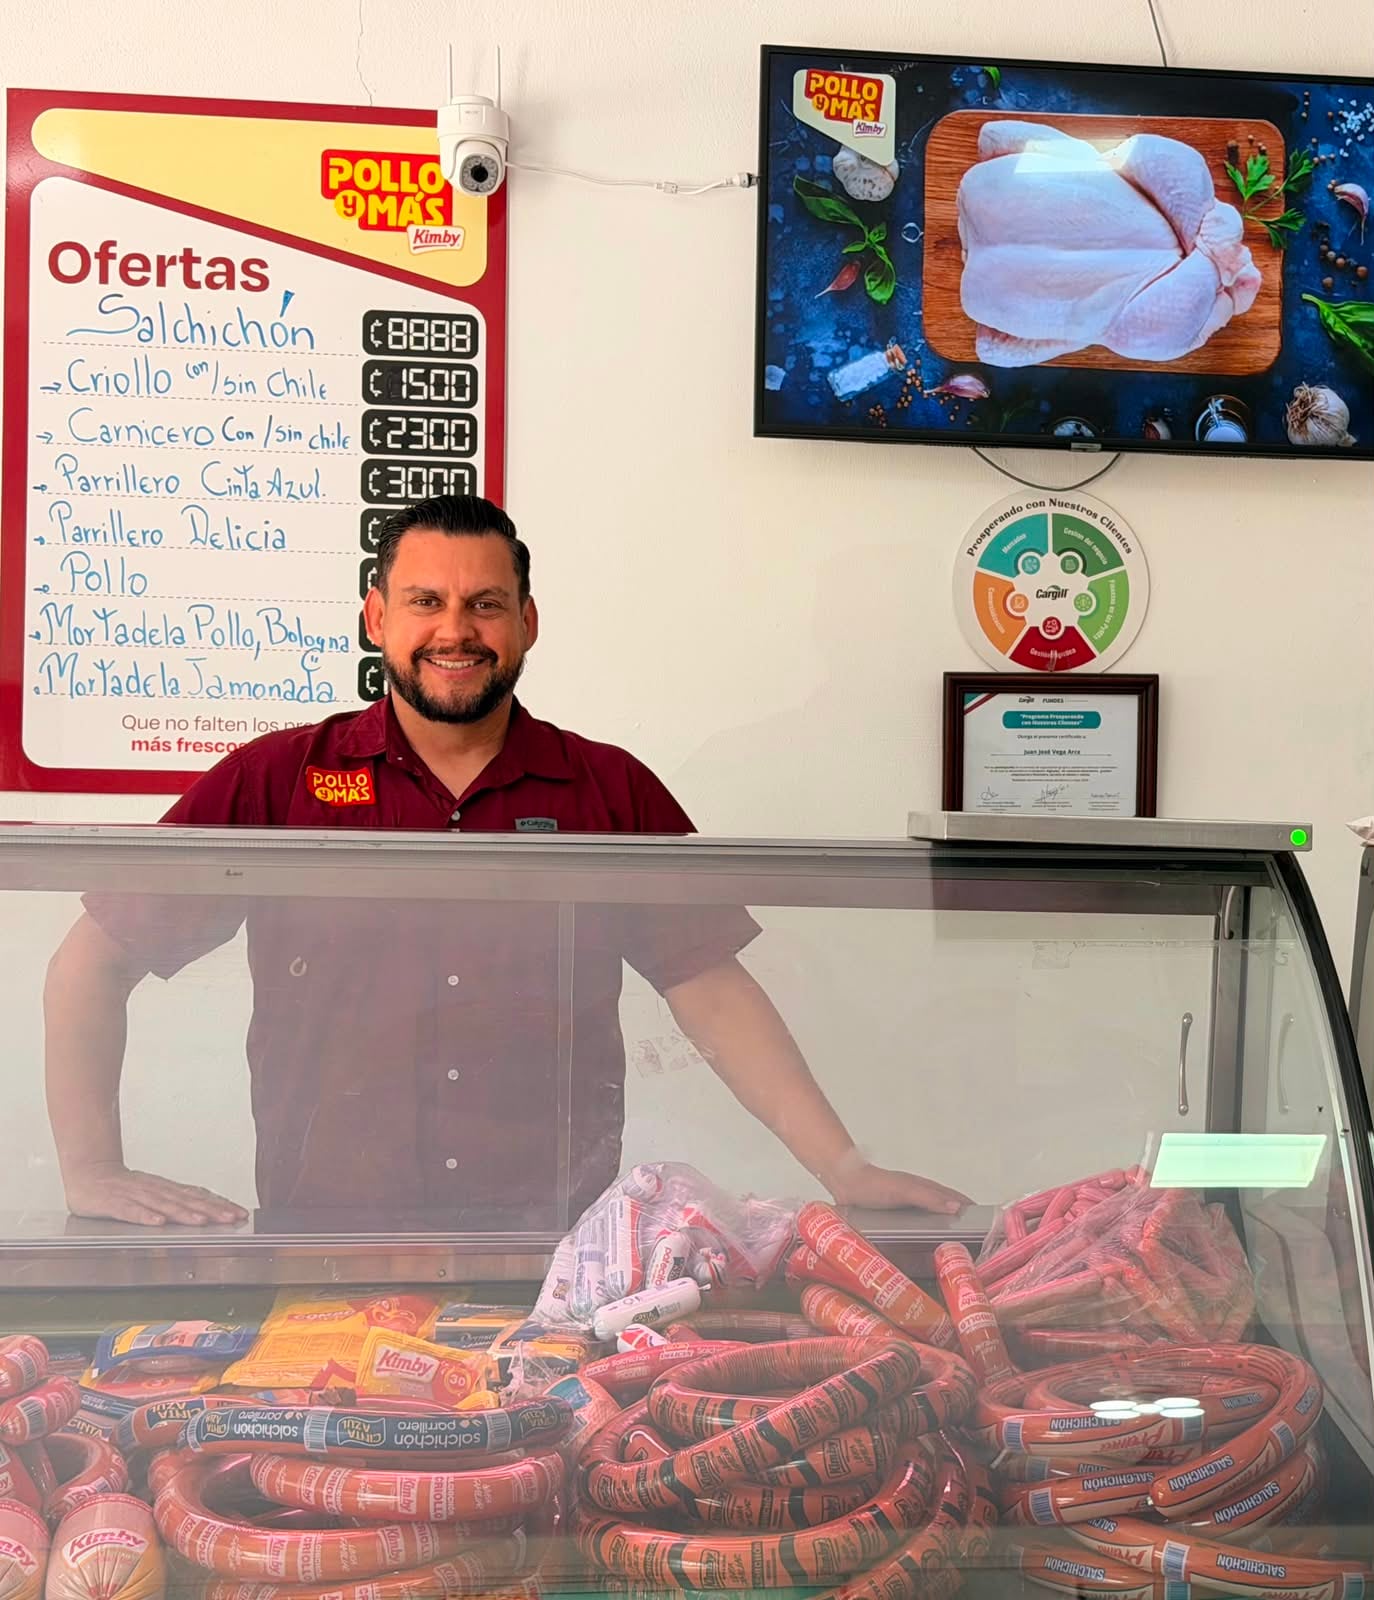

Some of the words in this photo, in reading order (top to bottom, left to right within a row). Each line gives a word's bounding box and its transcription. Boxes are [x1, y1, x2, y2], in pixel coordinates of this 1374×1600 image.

[809, 73, 879, 101] POLLO
[829, 98, 876, 122] MÁS
[855, 121, 884, 135] Kimby
[328, 157, 446, 195] POLLO
[367, 191, 445, 227] MÁS
[412, 228, 461, 248] Kimby
[48, 240, 271, 292] Ofertas
[66, 289, 315, 350] Salchichón
[67, 353, 172, 396] Criollo
[266, 368, 327, 400] Chile
[67, 406, 215, 446] Carnicero
[308, 421, 352, 450] chile
[54, 452, 181, 495] Parrillero
[201, 460, 262, 499] Cinta
[49, 500, 164, 547] Parrillero
[181, 504, 286, 550] Delicia
[966, 504, 1024, 557] Prosperando
[1025, 498, 1046, 510] con
[1049, 497, 1098, 520] Nuestros
[1100, 515, 1133, 555] Clientes
[60, 550, 148, 596] Pollo
[1035, 585, 1069, 601] Cargill
[184, 656, 336, 703] Jamonada
[121, 714, 161, 732] Que
[165, 719, 190, 732] no
[194, 715, 248, 732] falten
[252, 717, 280, 733] los
[131, 736, 172, 752] más
[312, 772, 368, 789] POLLO
[334, 785, 371, 803] MÁS
[377, 1349, 434, 1377] Kimby
[449, 1373, 467, 1387] 30
[233, 1423, 299, 1441] salchichón
[348, 1430, 382, 1444] CINTA
[394, 1432, 481, 1449] salchichón
[397, 1419, 457, 1431] parrillero
[1083, 1470, 1155, 1492] SALCHICHÓN
[1168, 1454, 1234, 1492] SALCHICHÓN
[400, 1477, 417, 1512] Kimby
[433, 1476, 446, 1519] CRIOLLO
[1213, 1480, 1281, 1524] SALCHICHÓN
[69, 1530, 146, 1556] Kimby
[269, 1537, 284, 1574] Kimby
[384, 1526, 402, 1563] Kimby
[302, 1536, 314, 1582] CRIOLLO
[1216, 1553, 1287, 1578] SALCHICHÓN
